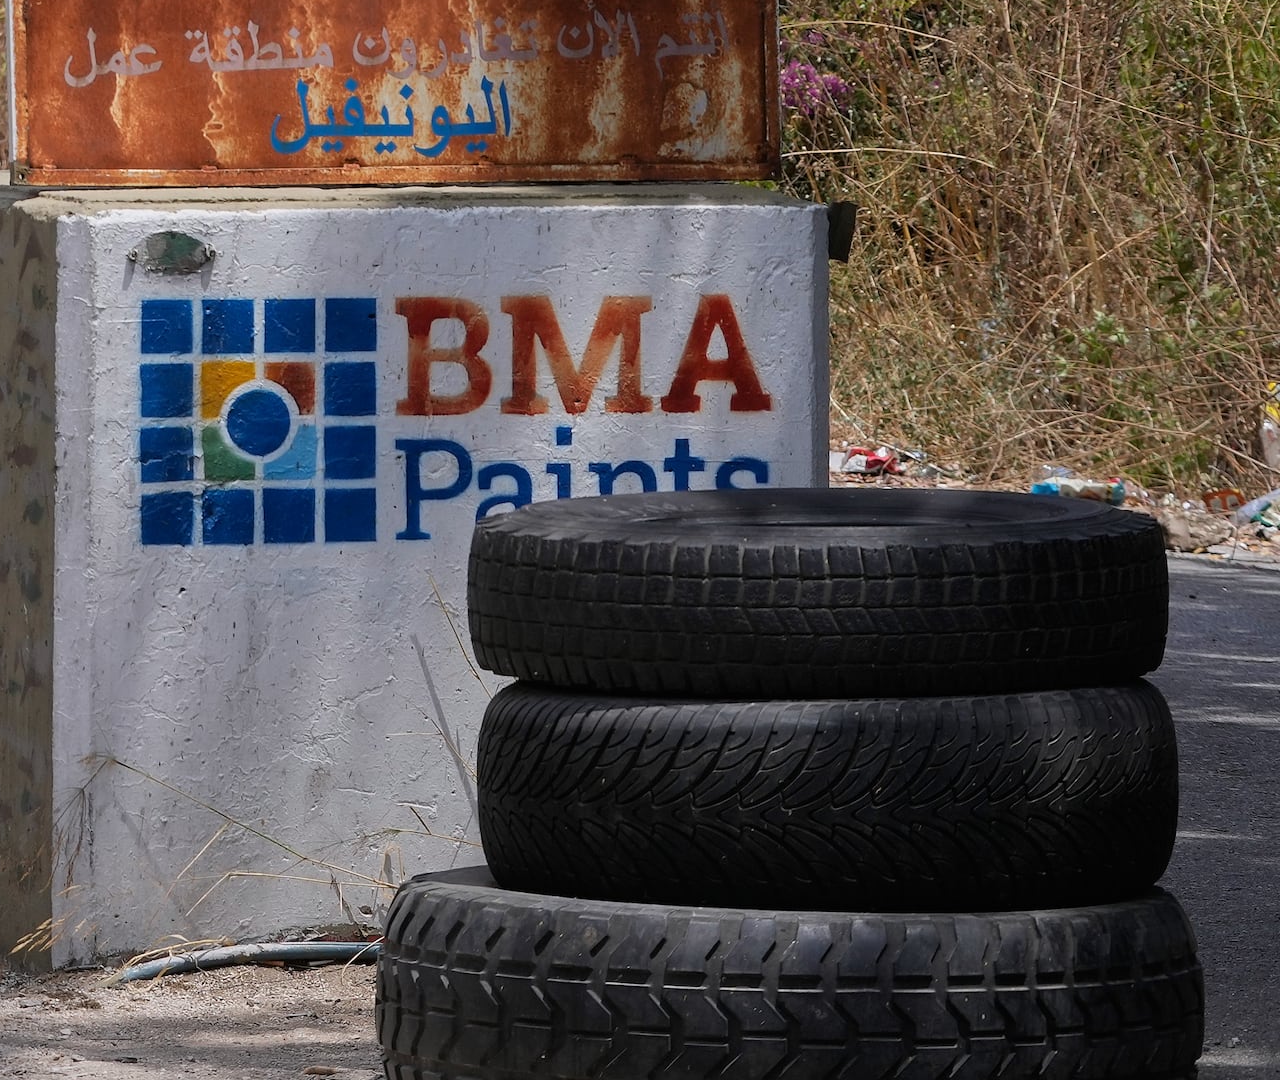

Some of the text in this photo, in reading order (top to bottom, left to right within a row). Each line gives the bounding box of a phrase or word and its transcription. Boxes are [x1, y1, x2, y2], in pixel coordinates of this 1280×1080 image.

[64, 27, 165, 88] عمل
[183, 22, 336, 75] منطقة
[351, 16, 540, 80] تغادرون
[269, 76, 514, 158] اليونيفيل
[395, 294, 774, 416] BMA
